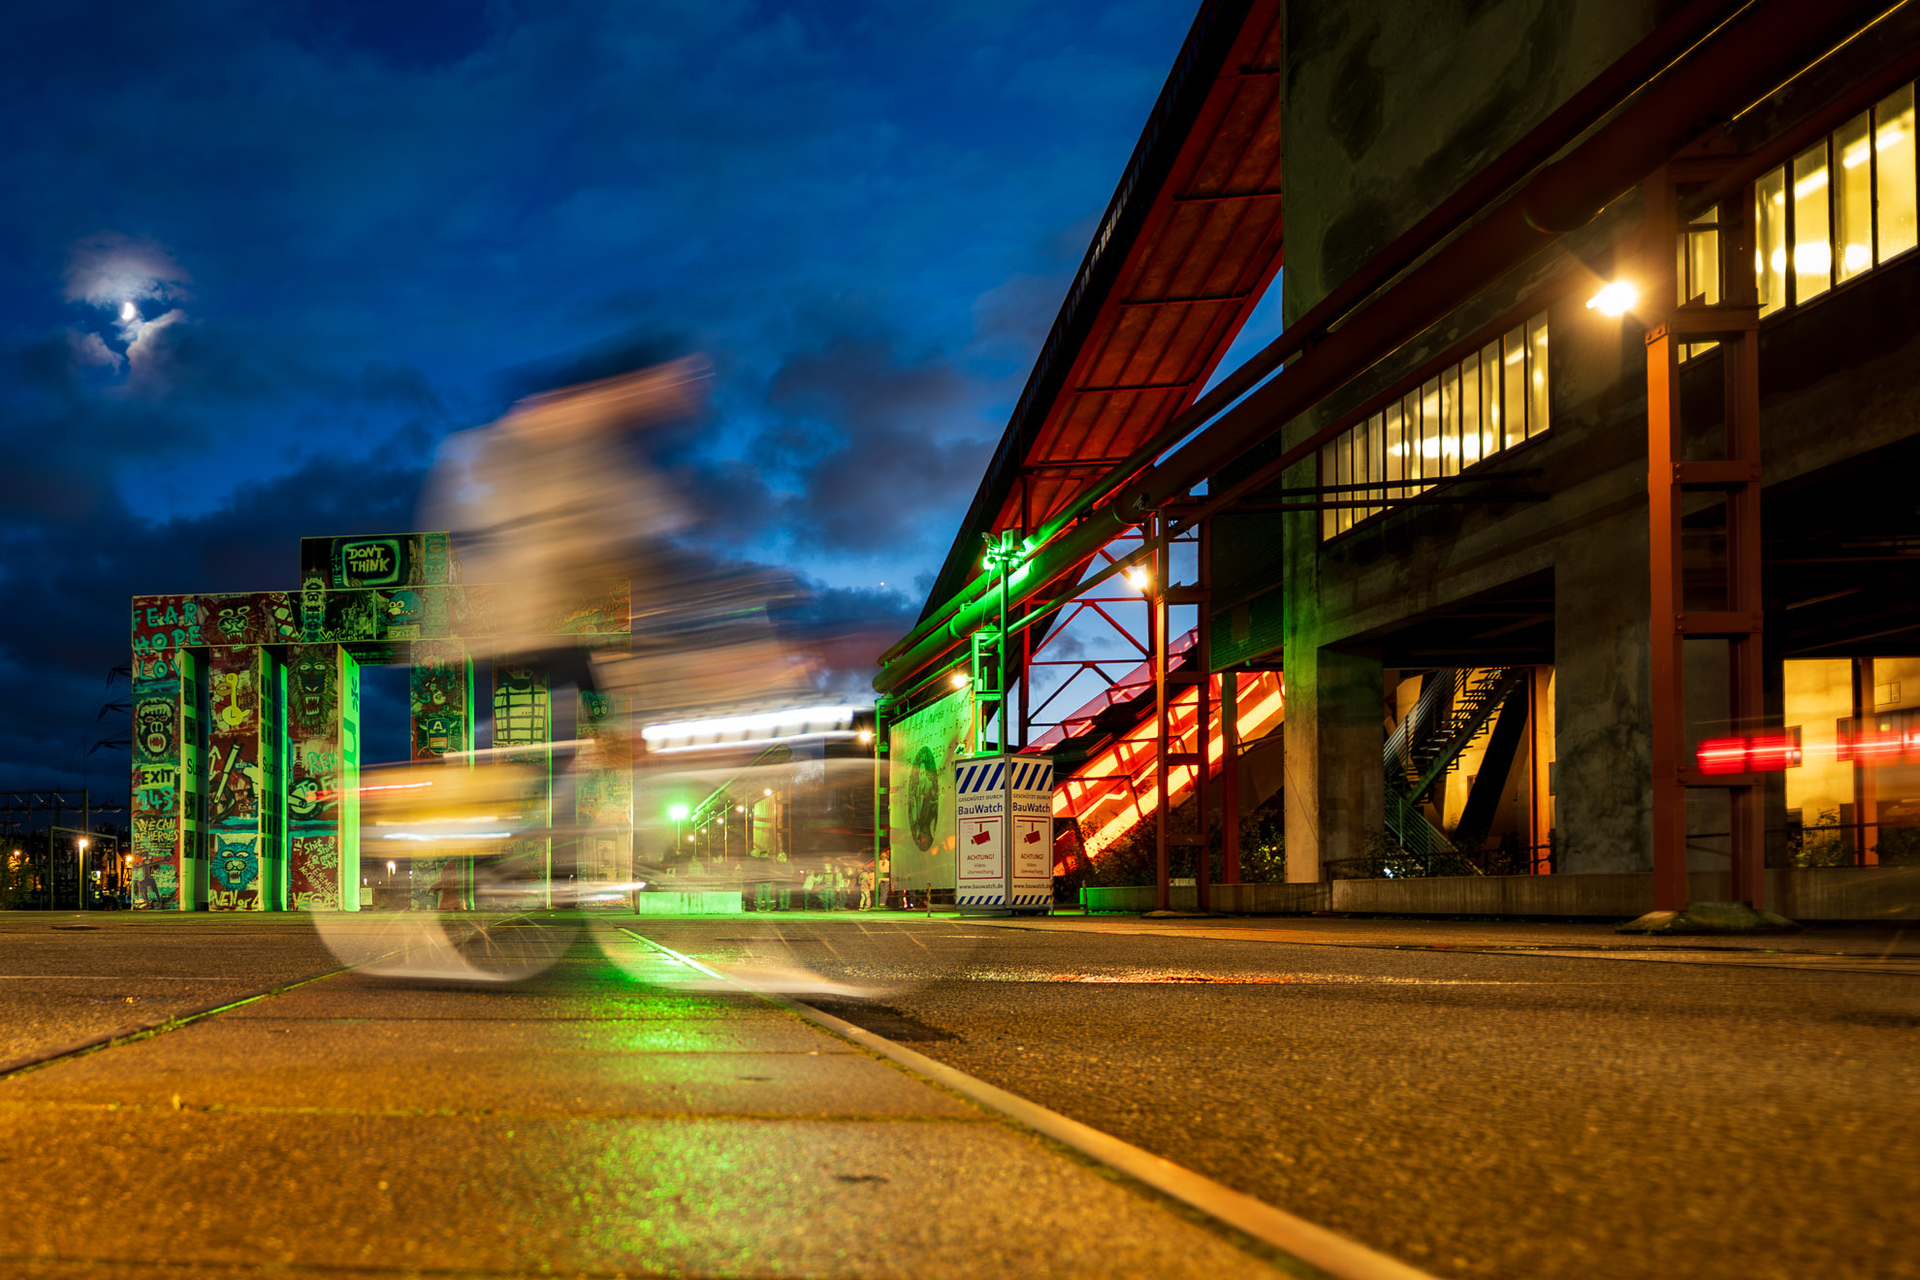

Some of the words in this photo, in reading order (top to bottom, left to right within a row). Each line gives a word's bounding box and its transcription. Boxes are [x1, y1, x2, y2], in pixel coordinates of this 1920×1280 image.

[347, 544, 385, 559] DON'T
[132, 602, 198, 632] FEAR
[134, 625, 203, 656] HOPE
[136, 786, 175, 811] 143
[958, 802, 1003, 815] BauWatch
[1013, 802, 1050, 813] BauWatch
